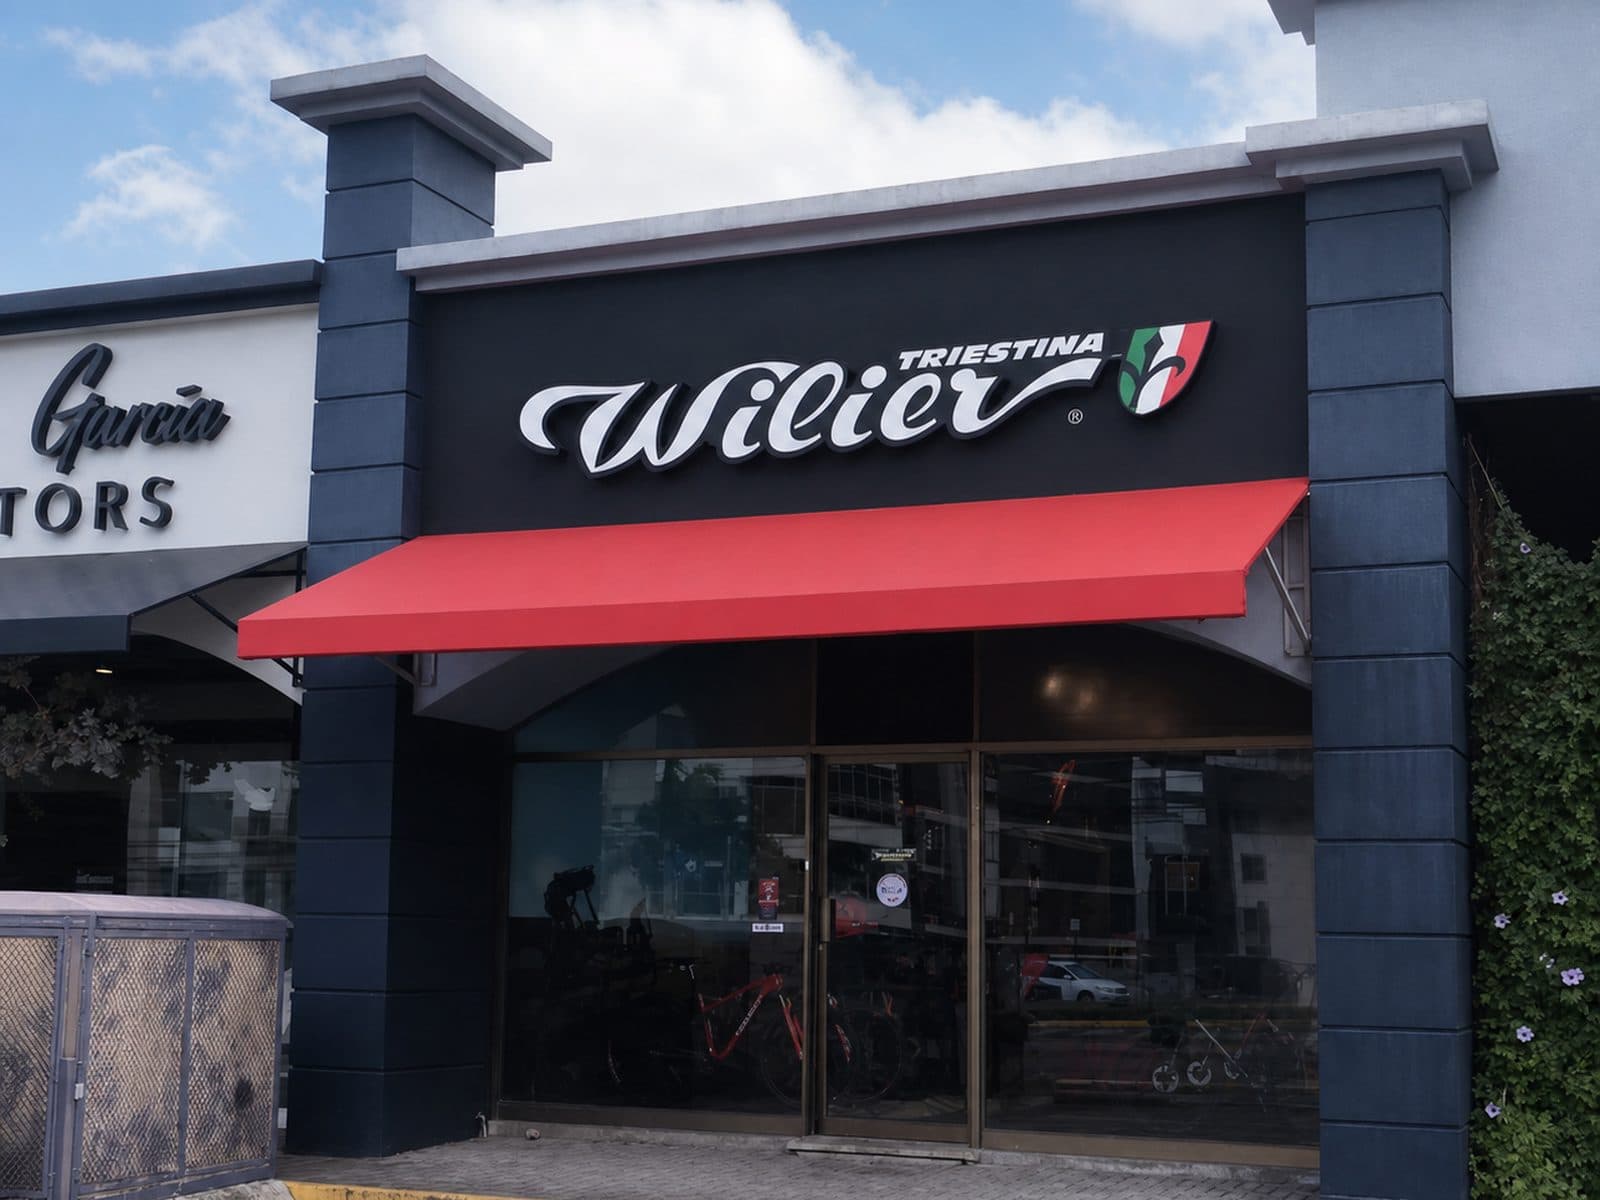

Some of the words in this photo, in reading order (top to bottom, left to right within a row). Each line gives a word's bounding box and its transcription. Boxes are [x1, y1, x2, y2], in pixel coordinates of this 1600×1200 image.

[898, 331, 1106, 371] TRIESTINA
[518, 356, 1104, 475] Wilier
[0, 476, 175, 538] TORS
